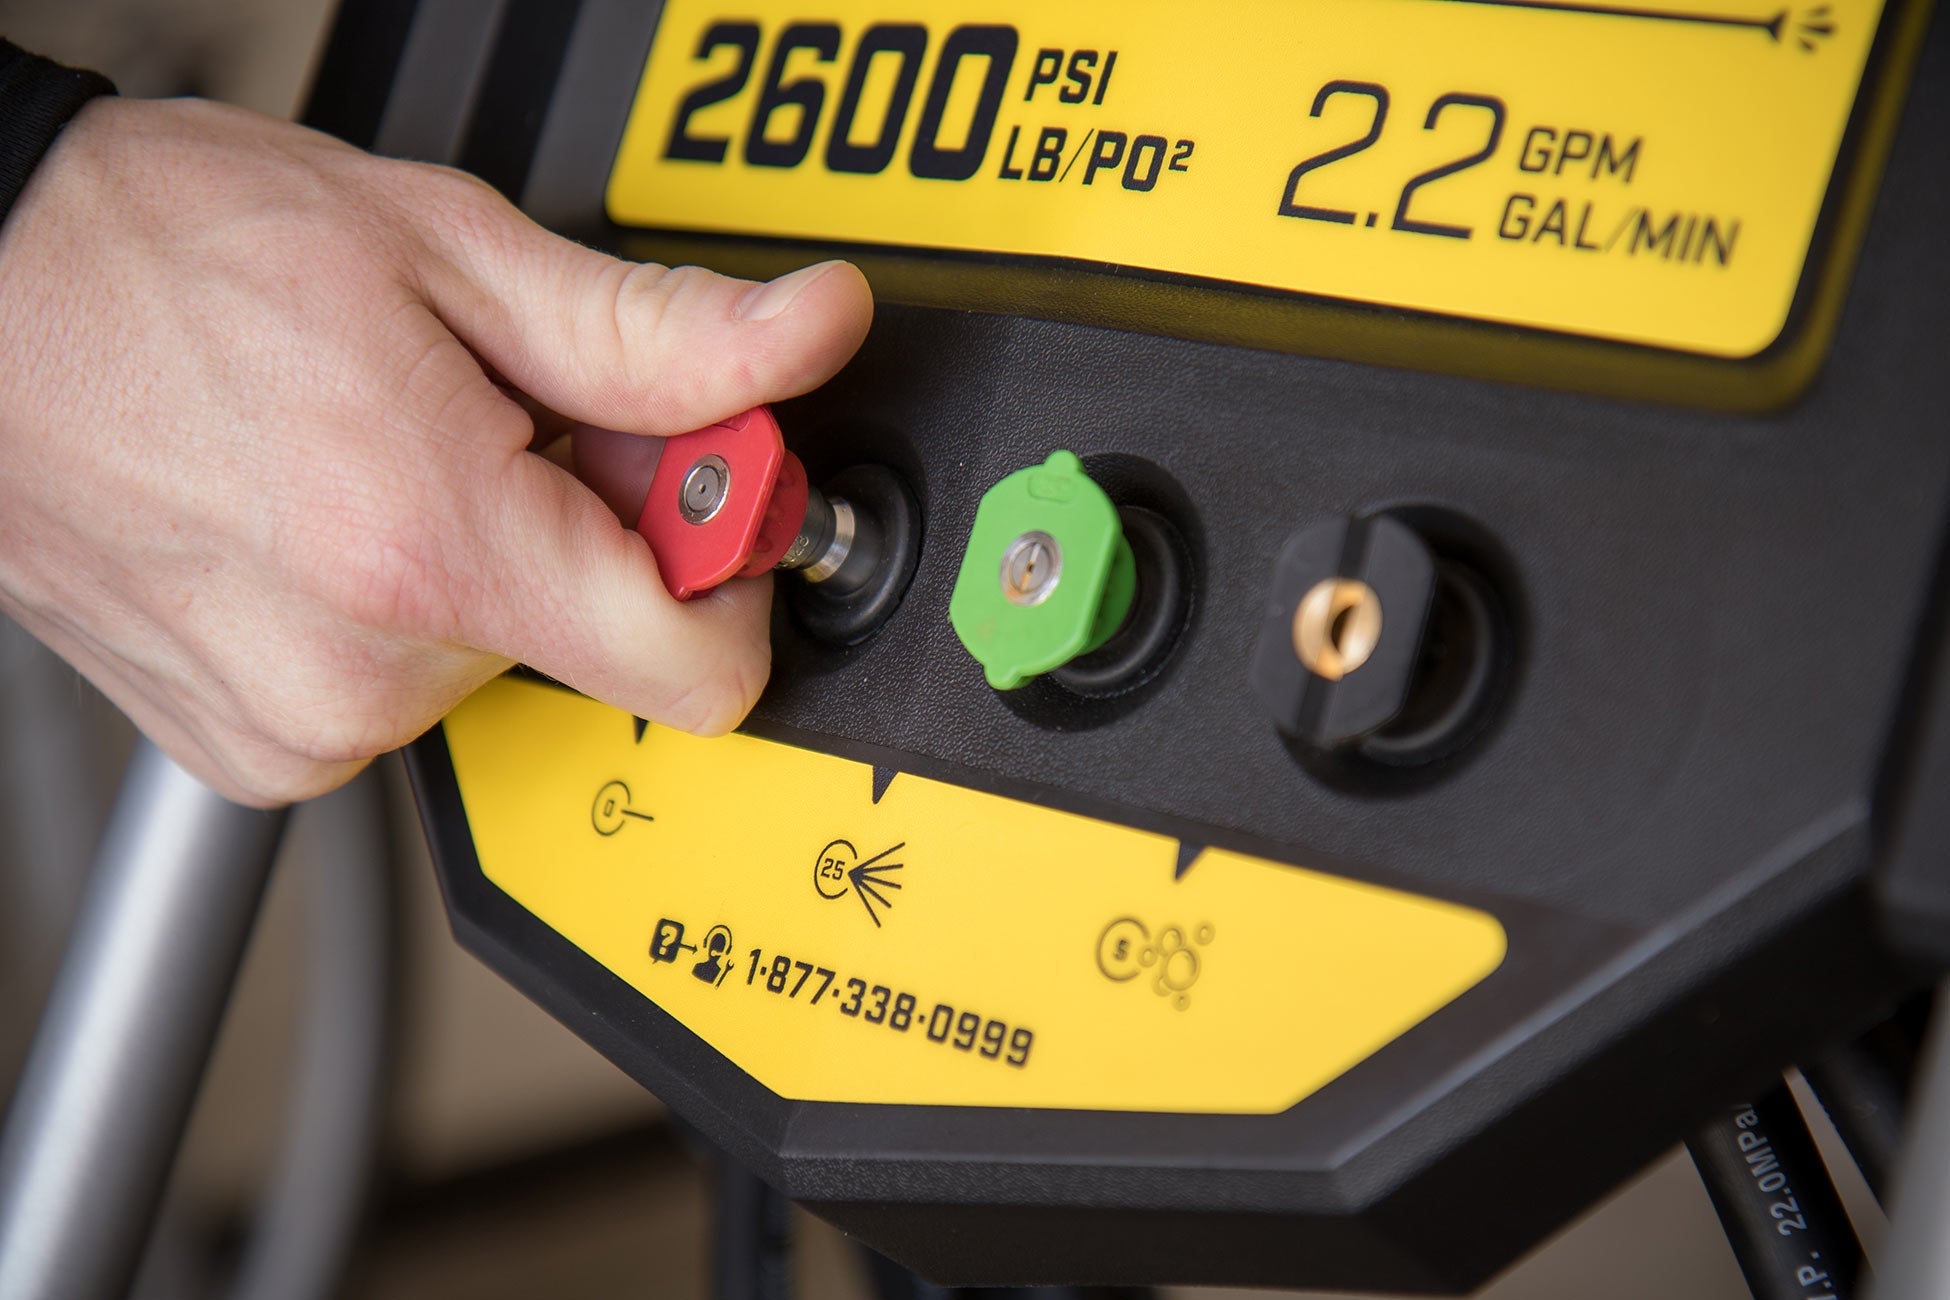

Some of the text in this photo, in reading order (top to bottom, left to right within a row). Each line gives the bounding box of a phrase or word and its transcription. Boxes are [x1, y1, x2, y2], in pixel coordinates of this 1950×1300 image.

[660, 18, 1118, 181] 2600 PSI
[997, 123, 1195, 193] LB/PO²
[1277, 79, 1643, 240] 2.2 GPM
[1497, 193, 1740, 268] GAL/MIN
[819, 856, 845, 881] 25
